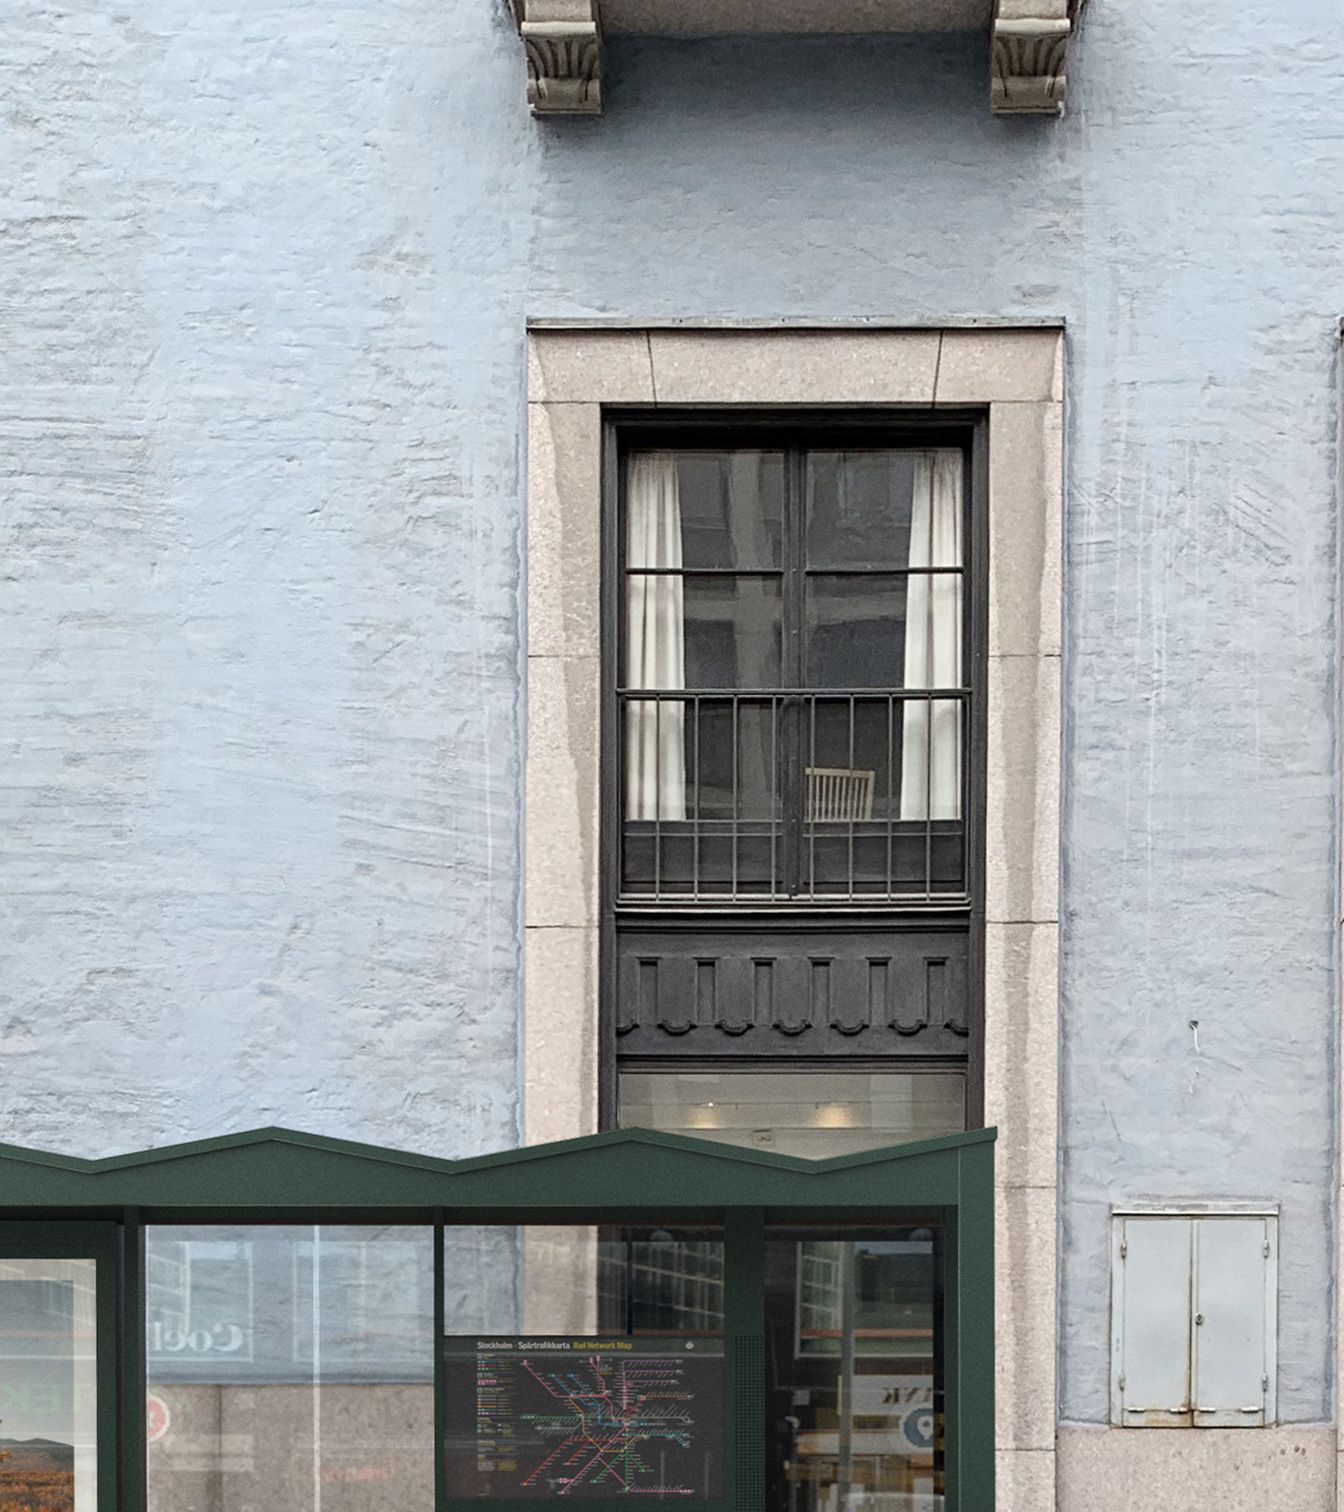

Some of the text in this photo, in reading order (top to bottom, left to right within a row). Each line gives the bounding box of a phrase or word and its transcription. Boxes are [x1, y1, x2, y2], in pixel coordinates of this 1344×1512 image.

[477, 1341, 512, 1349] Stockholm
[573, 1341, 586, 1349] Rail
[588, 1341, 615, 1349] Network
[617, 1341, 632, 1350] Map
